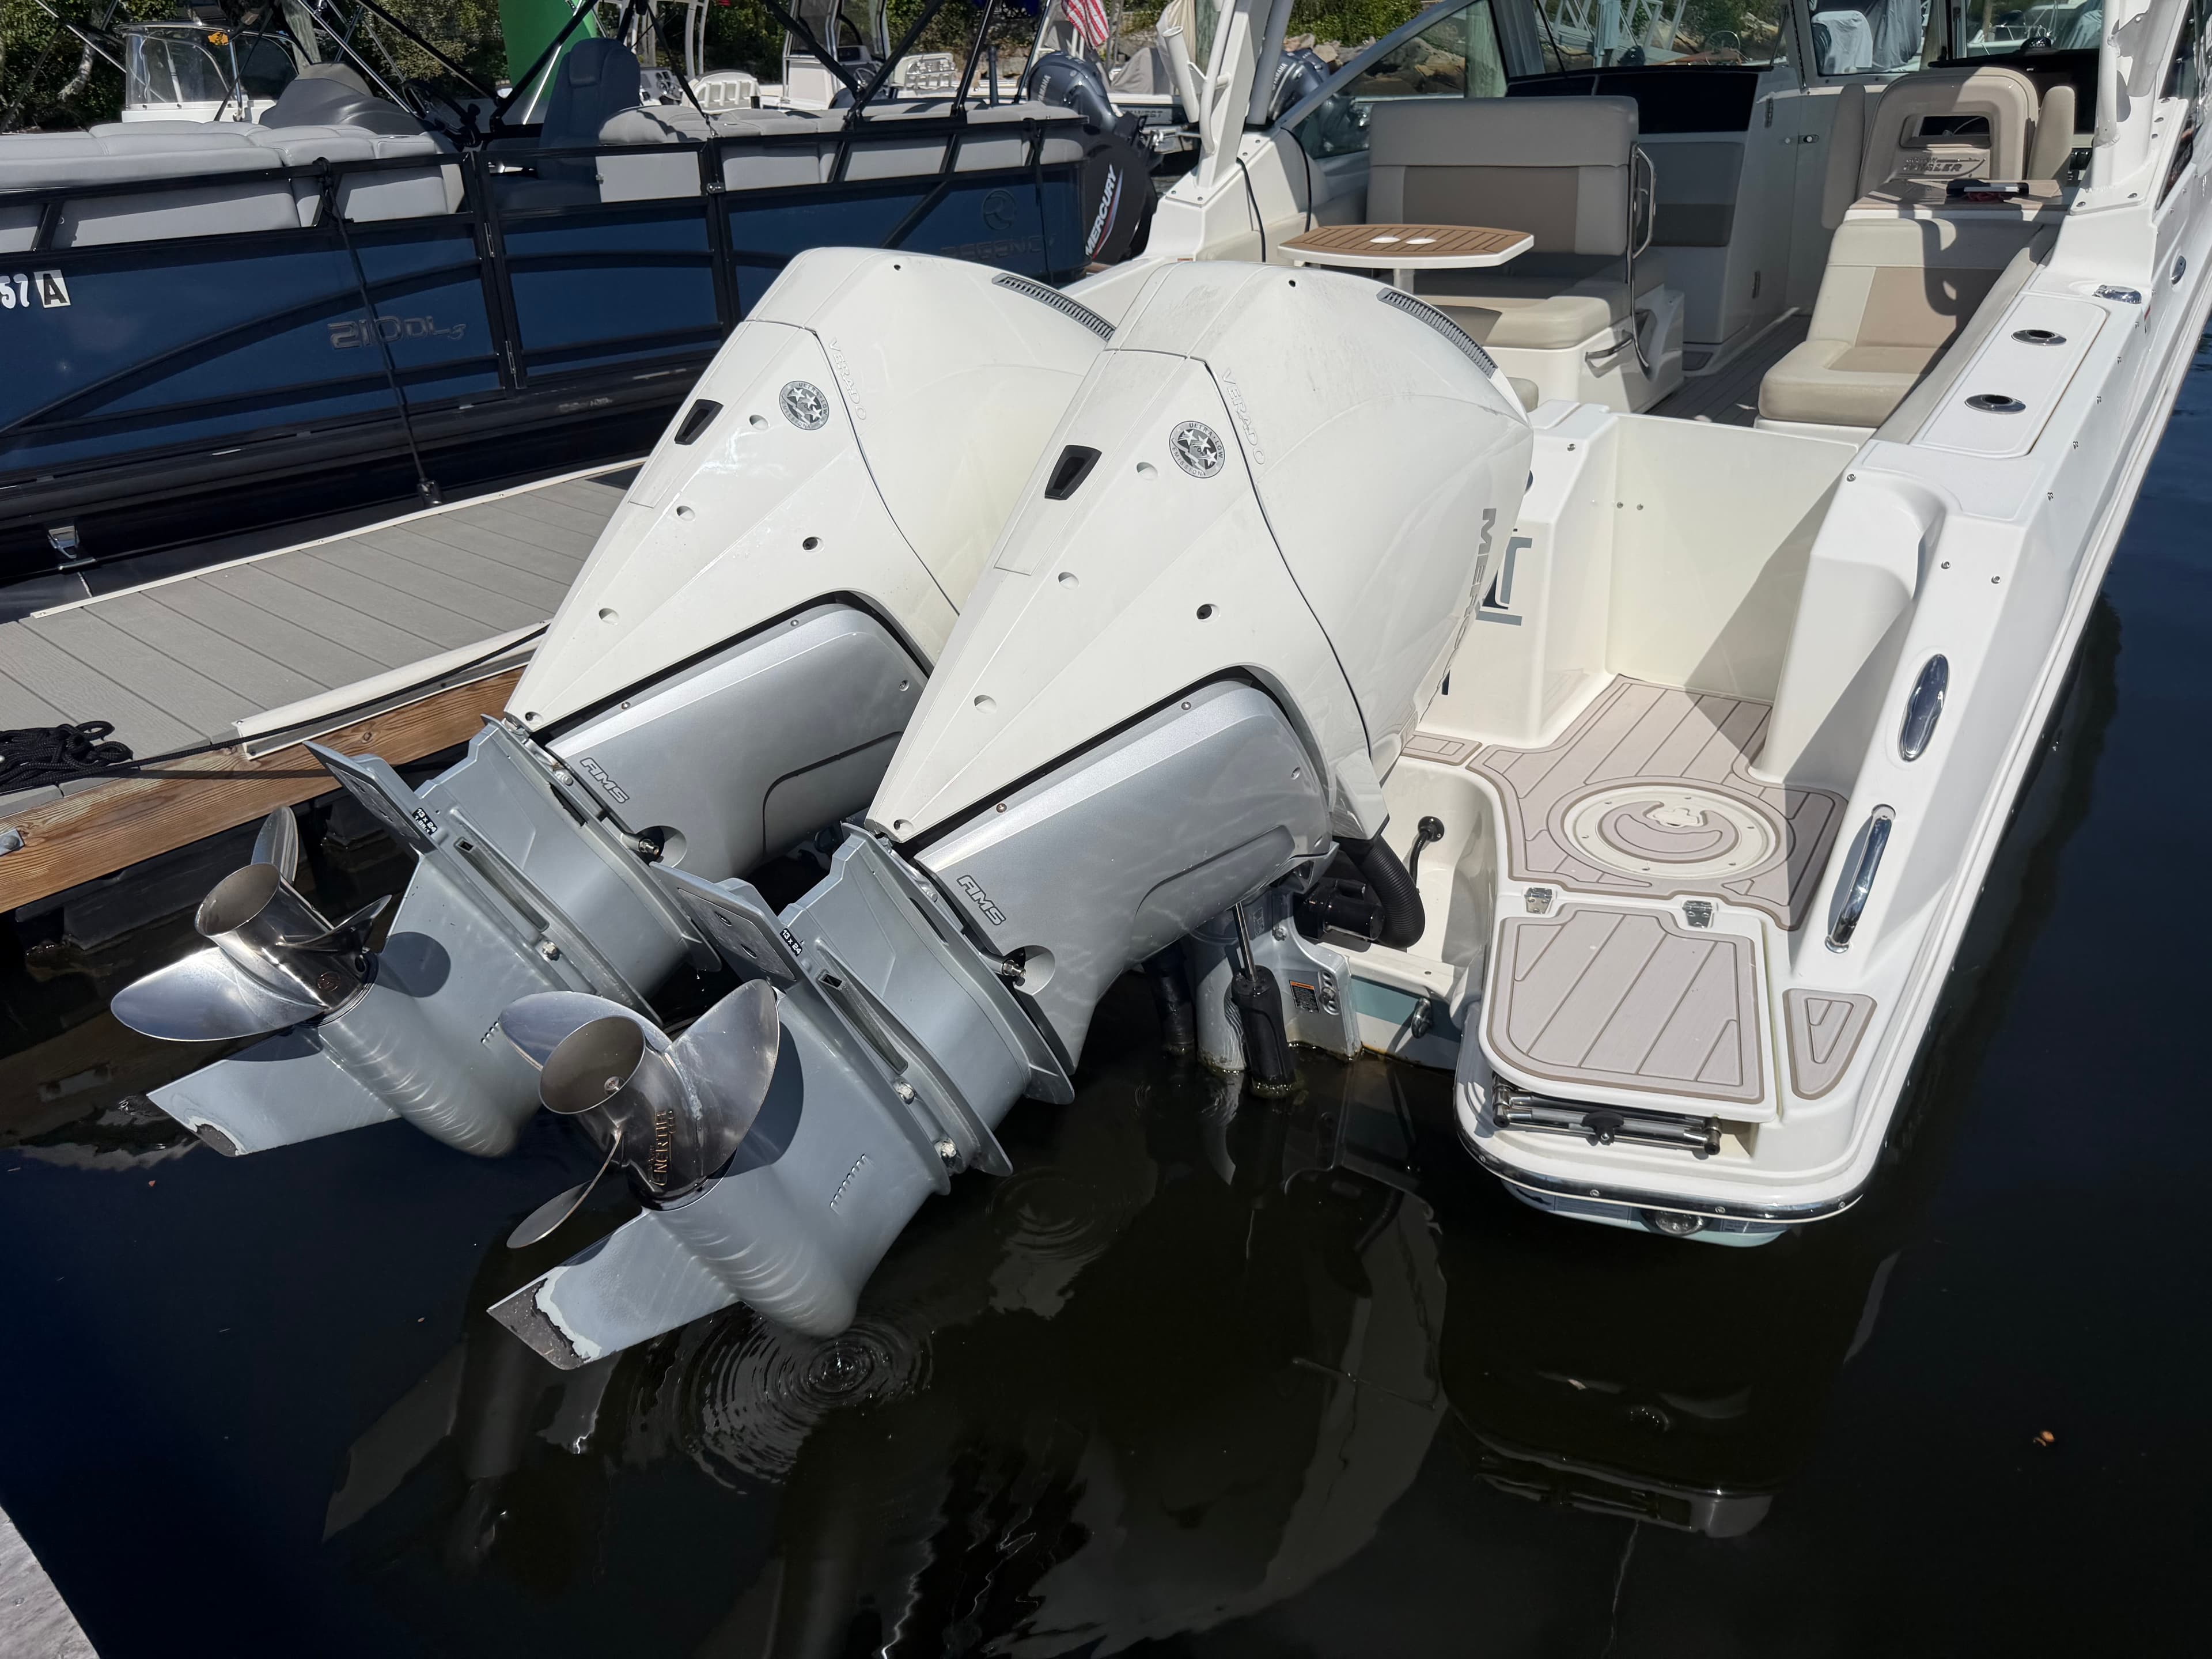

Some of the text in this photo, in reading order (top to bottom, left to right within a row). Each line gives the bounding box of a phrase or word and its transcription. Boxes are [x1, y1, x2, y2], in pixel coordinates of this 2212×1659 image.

[1085, 164, 1116, 256] MERCURY
[43, 273, 68, 305] A
[828, 336, 867, 421] VERADO
[1222, 366, 1266, 465] VERADO
[1189, 422, 1224, 459] ULTRA LOW
[579, 757, 630, 804] AMS
[417, 808, 426, 818] 13
[427, 821, 437, 832] 24
[956, 874, 1007, 926] AMS
[782, 929, 791, 940] 13
[791, 942, 802, 955] 24
